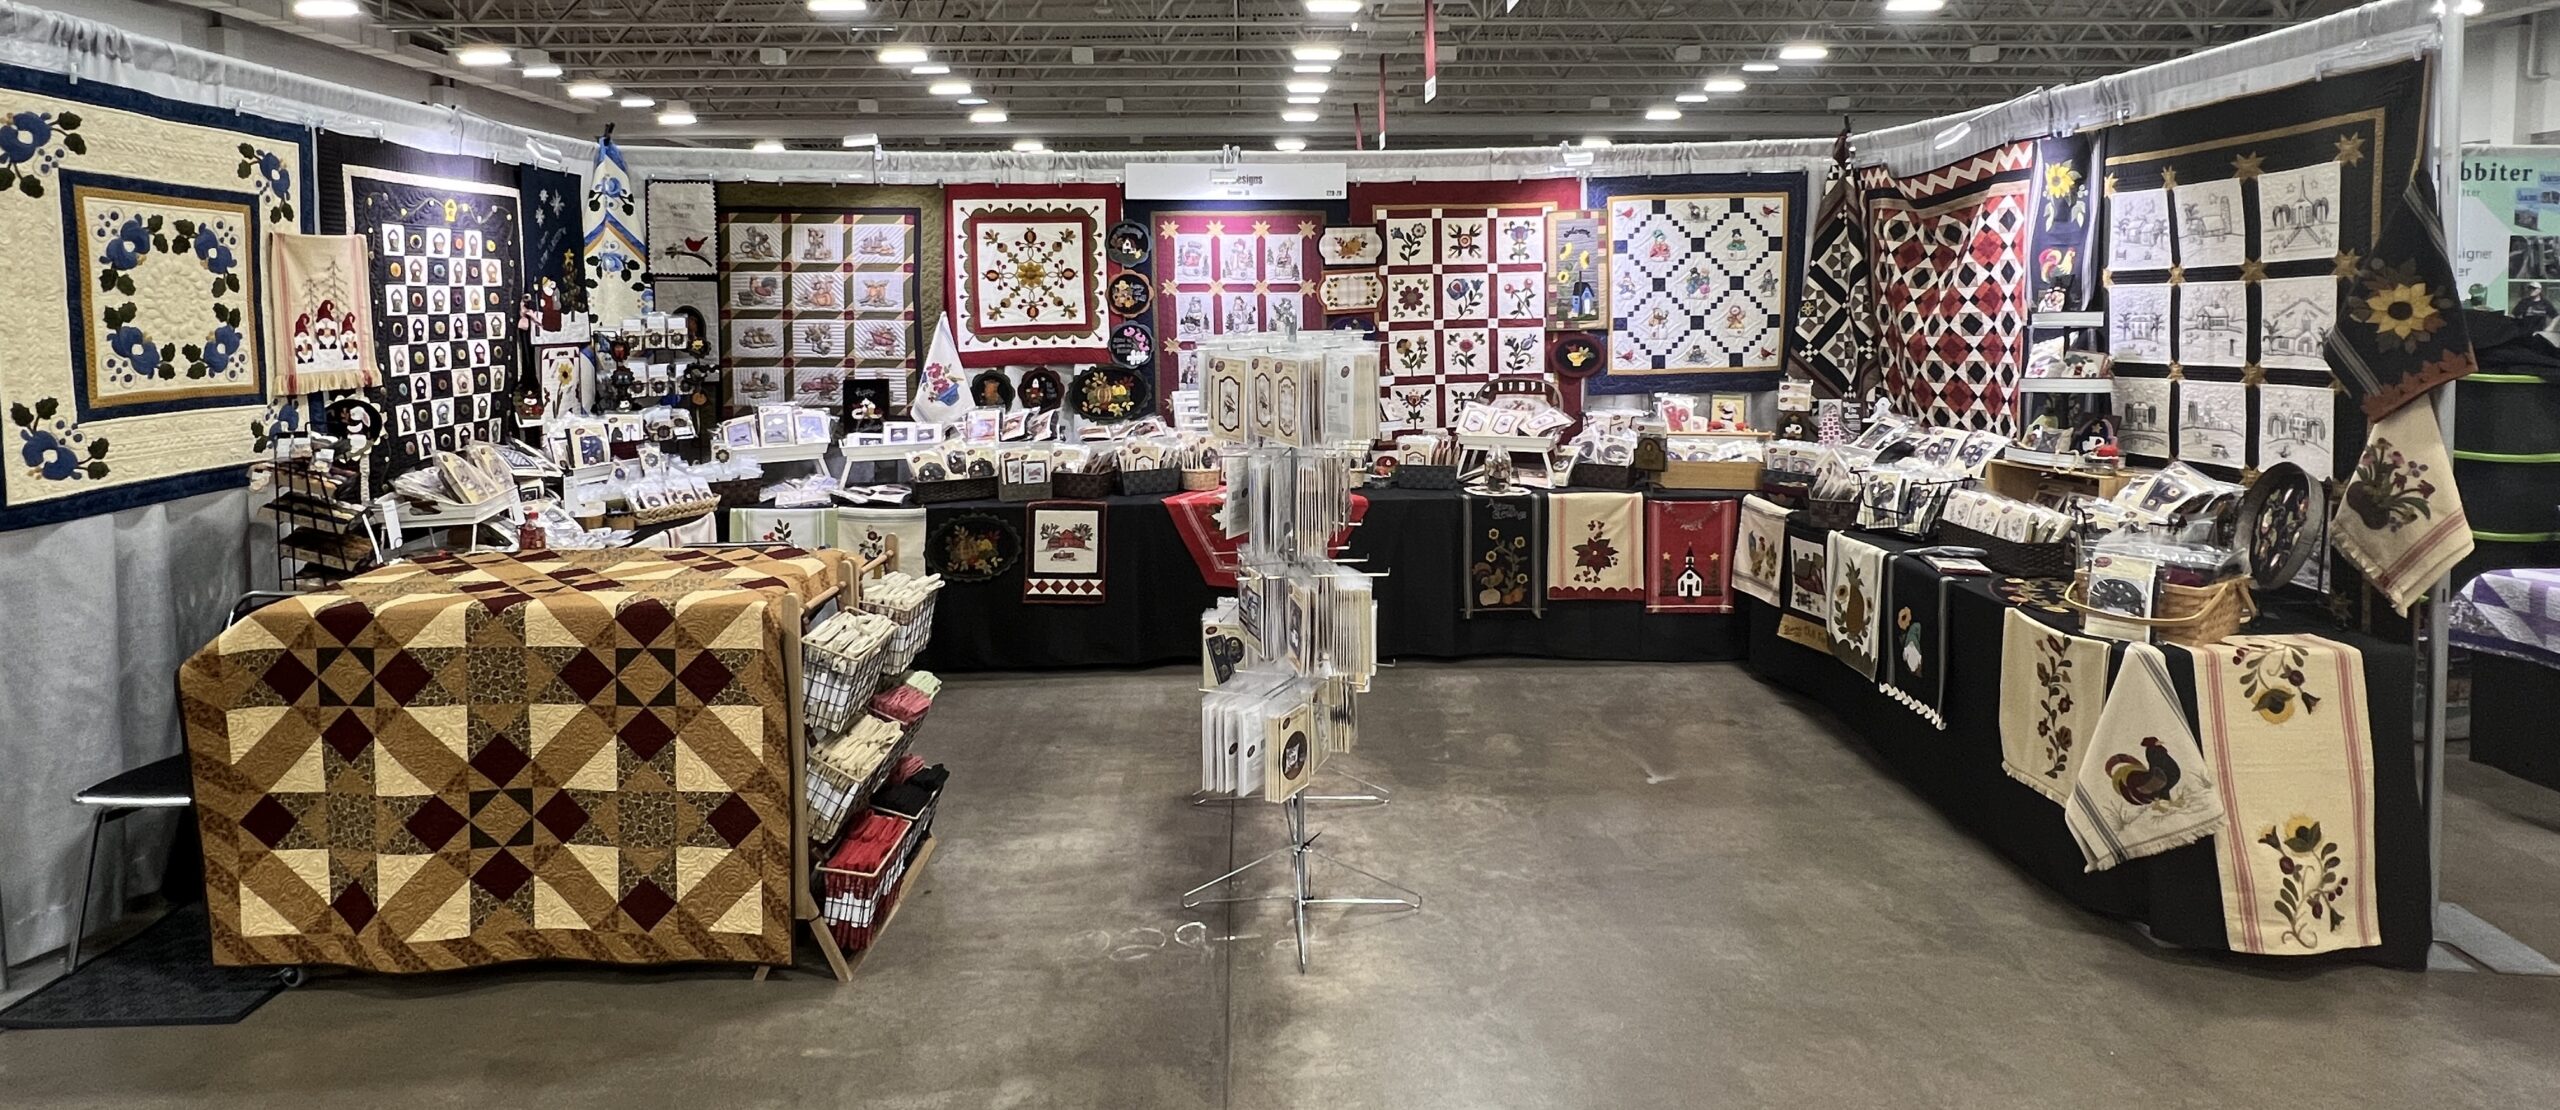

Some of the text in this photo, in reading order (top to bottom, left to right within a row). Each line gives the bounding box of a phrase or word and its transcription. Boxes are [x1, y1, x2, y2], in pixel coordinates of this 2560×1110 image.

[2437, 162, 2533, 181] bbiter
[1233, 174, 1263, 186] esigns
[2459, 248, 2493, 261] igner
